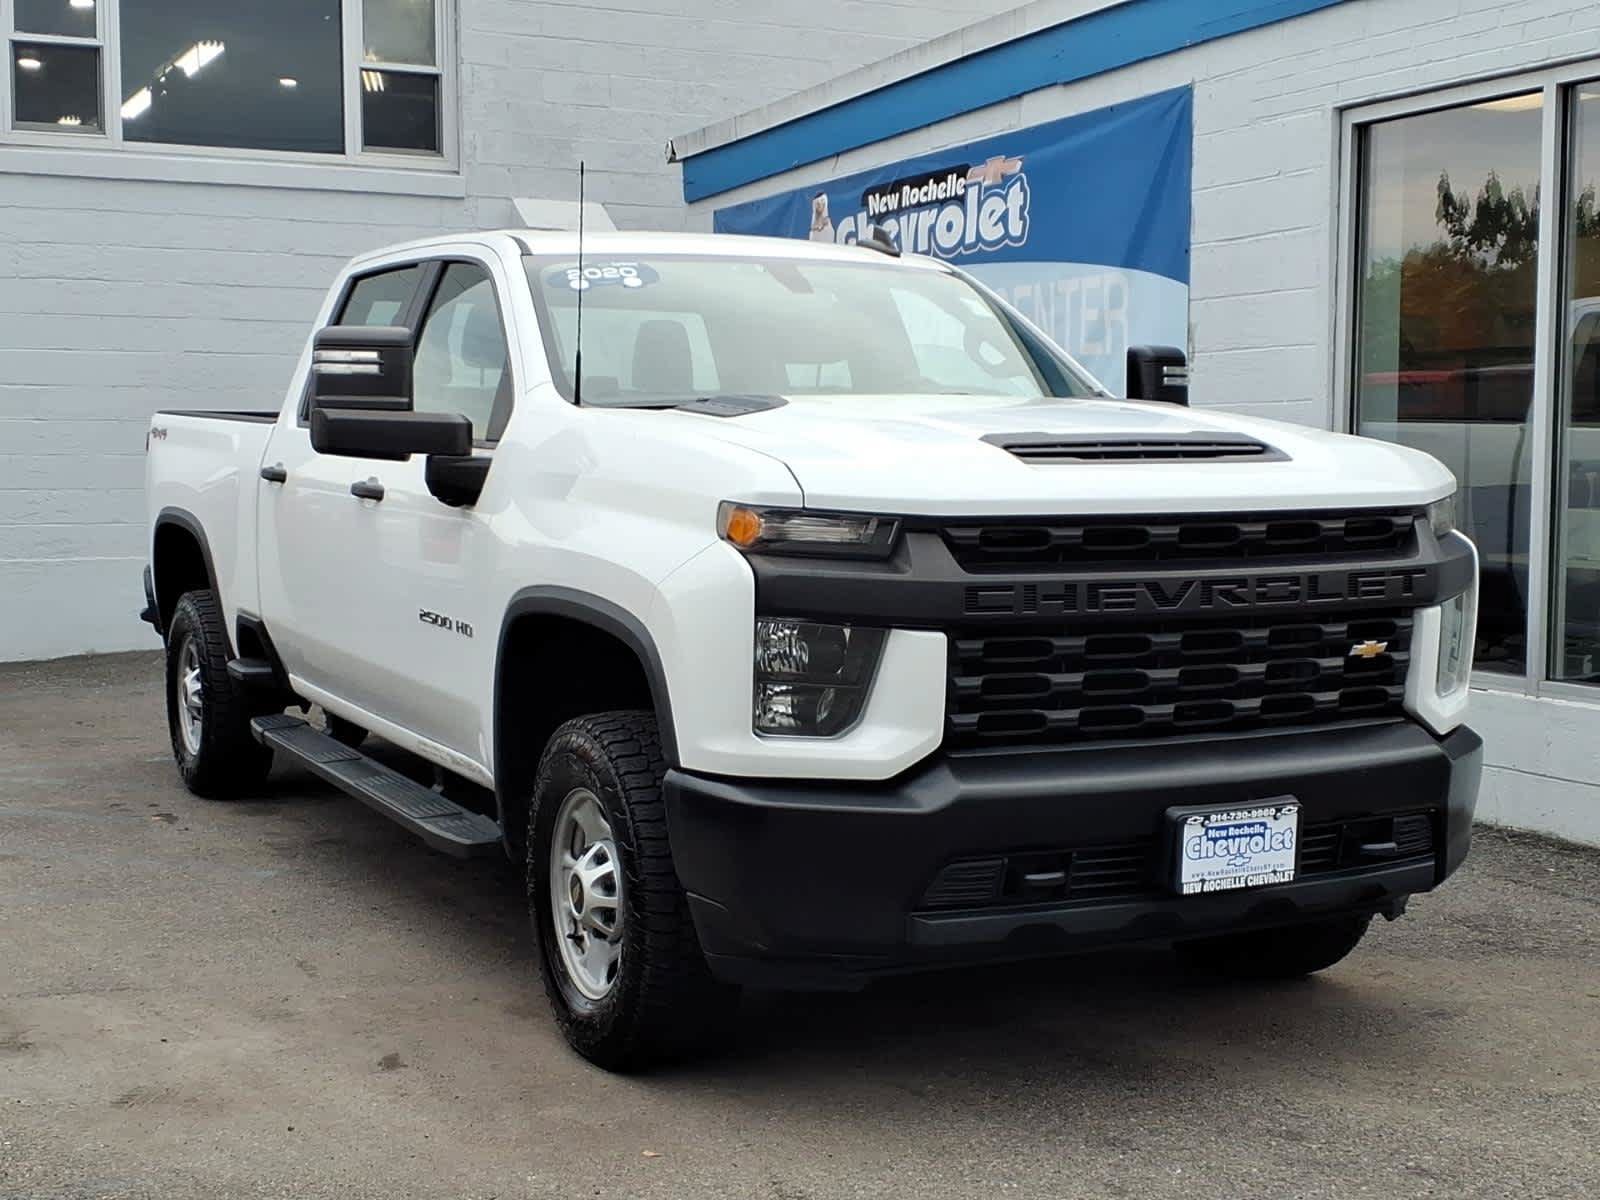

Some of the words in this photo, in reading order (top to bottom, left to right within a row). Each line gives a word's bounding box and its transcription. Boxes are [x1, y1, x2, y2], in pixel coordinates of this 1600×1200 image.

[868, 191, 901, 216] New
[902, 173, 966, 206] Rochelle
[566, 266, 638, 281] 2020
[963, 568, 1427, 616] CHEVROLET
[419, 608, 453, 630] 2500
[455, 620, 473, 638] HD
[1186, 828, 1294, 860] Chevrolet
[1208, 828, 1227, 838] New
[1228, 823, 1265, 836] Rochelle
[1183, 881, 1203, 895] NEW
[1247, 870, 1295, 886] CHEVROLET
